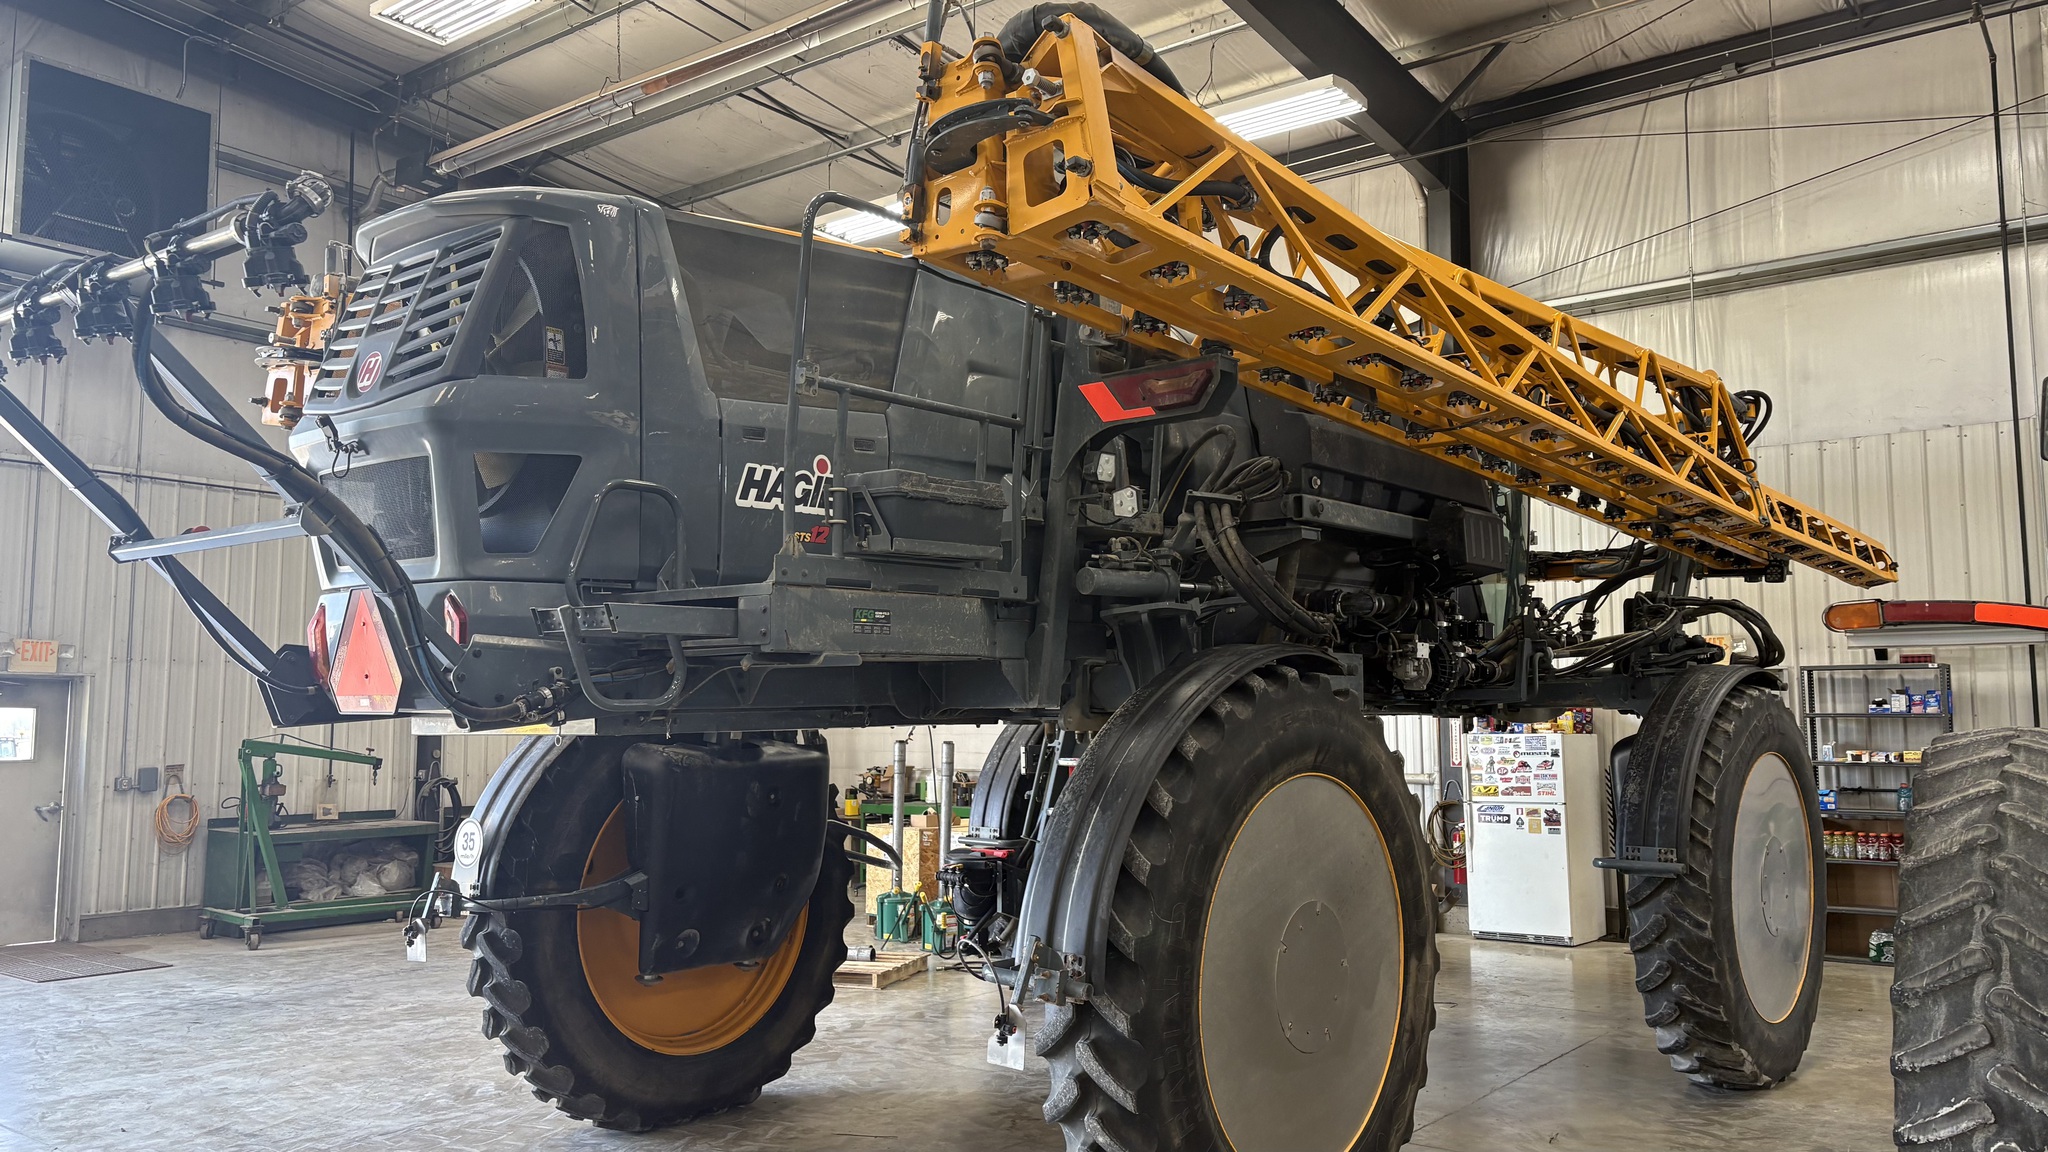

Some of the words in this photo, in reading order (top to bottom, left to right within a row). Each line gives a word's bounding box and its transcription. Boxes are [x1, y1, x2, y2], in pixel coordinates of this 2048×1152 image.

[855, 609, 875, 619] KFG
[21, 640, 52, 662] EXIT
[462, 832, 476, 851] 35
